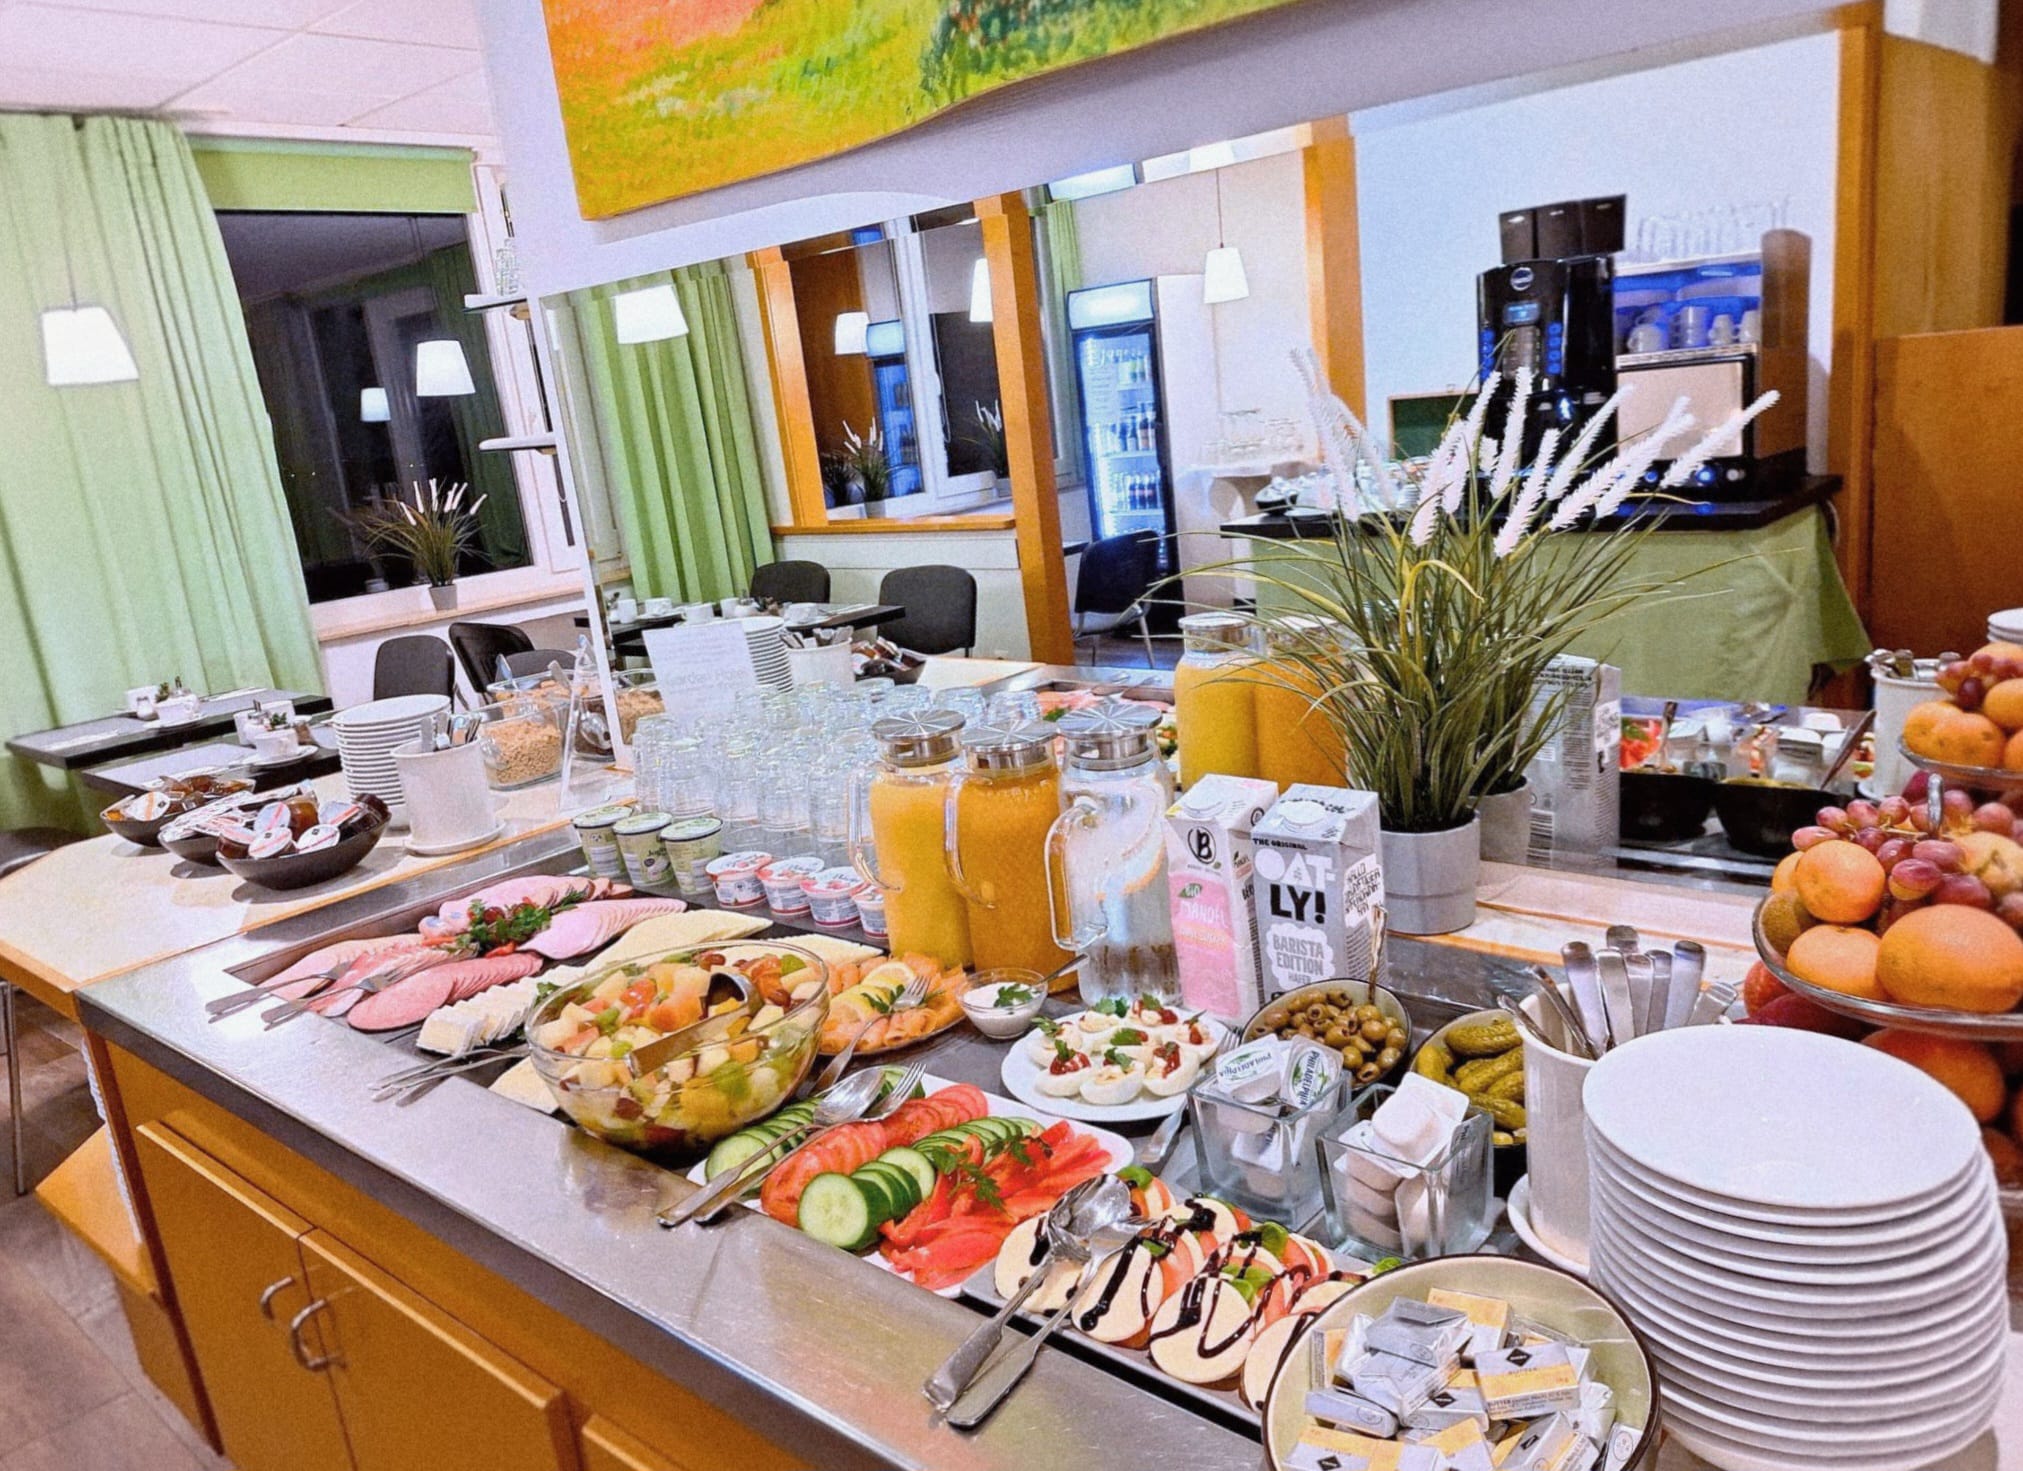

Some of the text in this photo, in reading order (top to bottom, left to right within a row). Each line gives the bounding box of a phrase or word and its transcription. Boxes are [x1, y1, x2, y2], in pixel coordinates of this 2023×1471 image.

[1252, 837, 1270, 846] THE
[1270, 883, 1327, 924] LY!
[1273, 933, 1325, 960] BARISTA
[1276, 951, 1324, 977] EDITION
[1300, 1050, 1320, 1106] PHILADELPHIA
